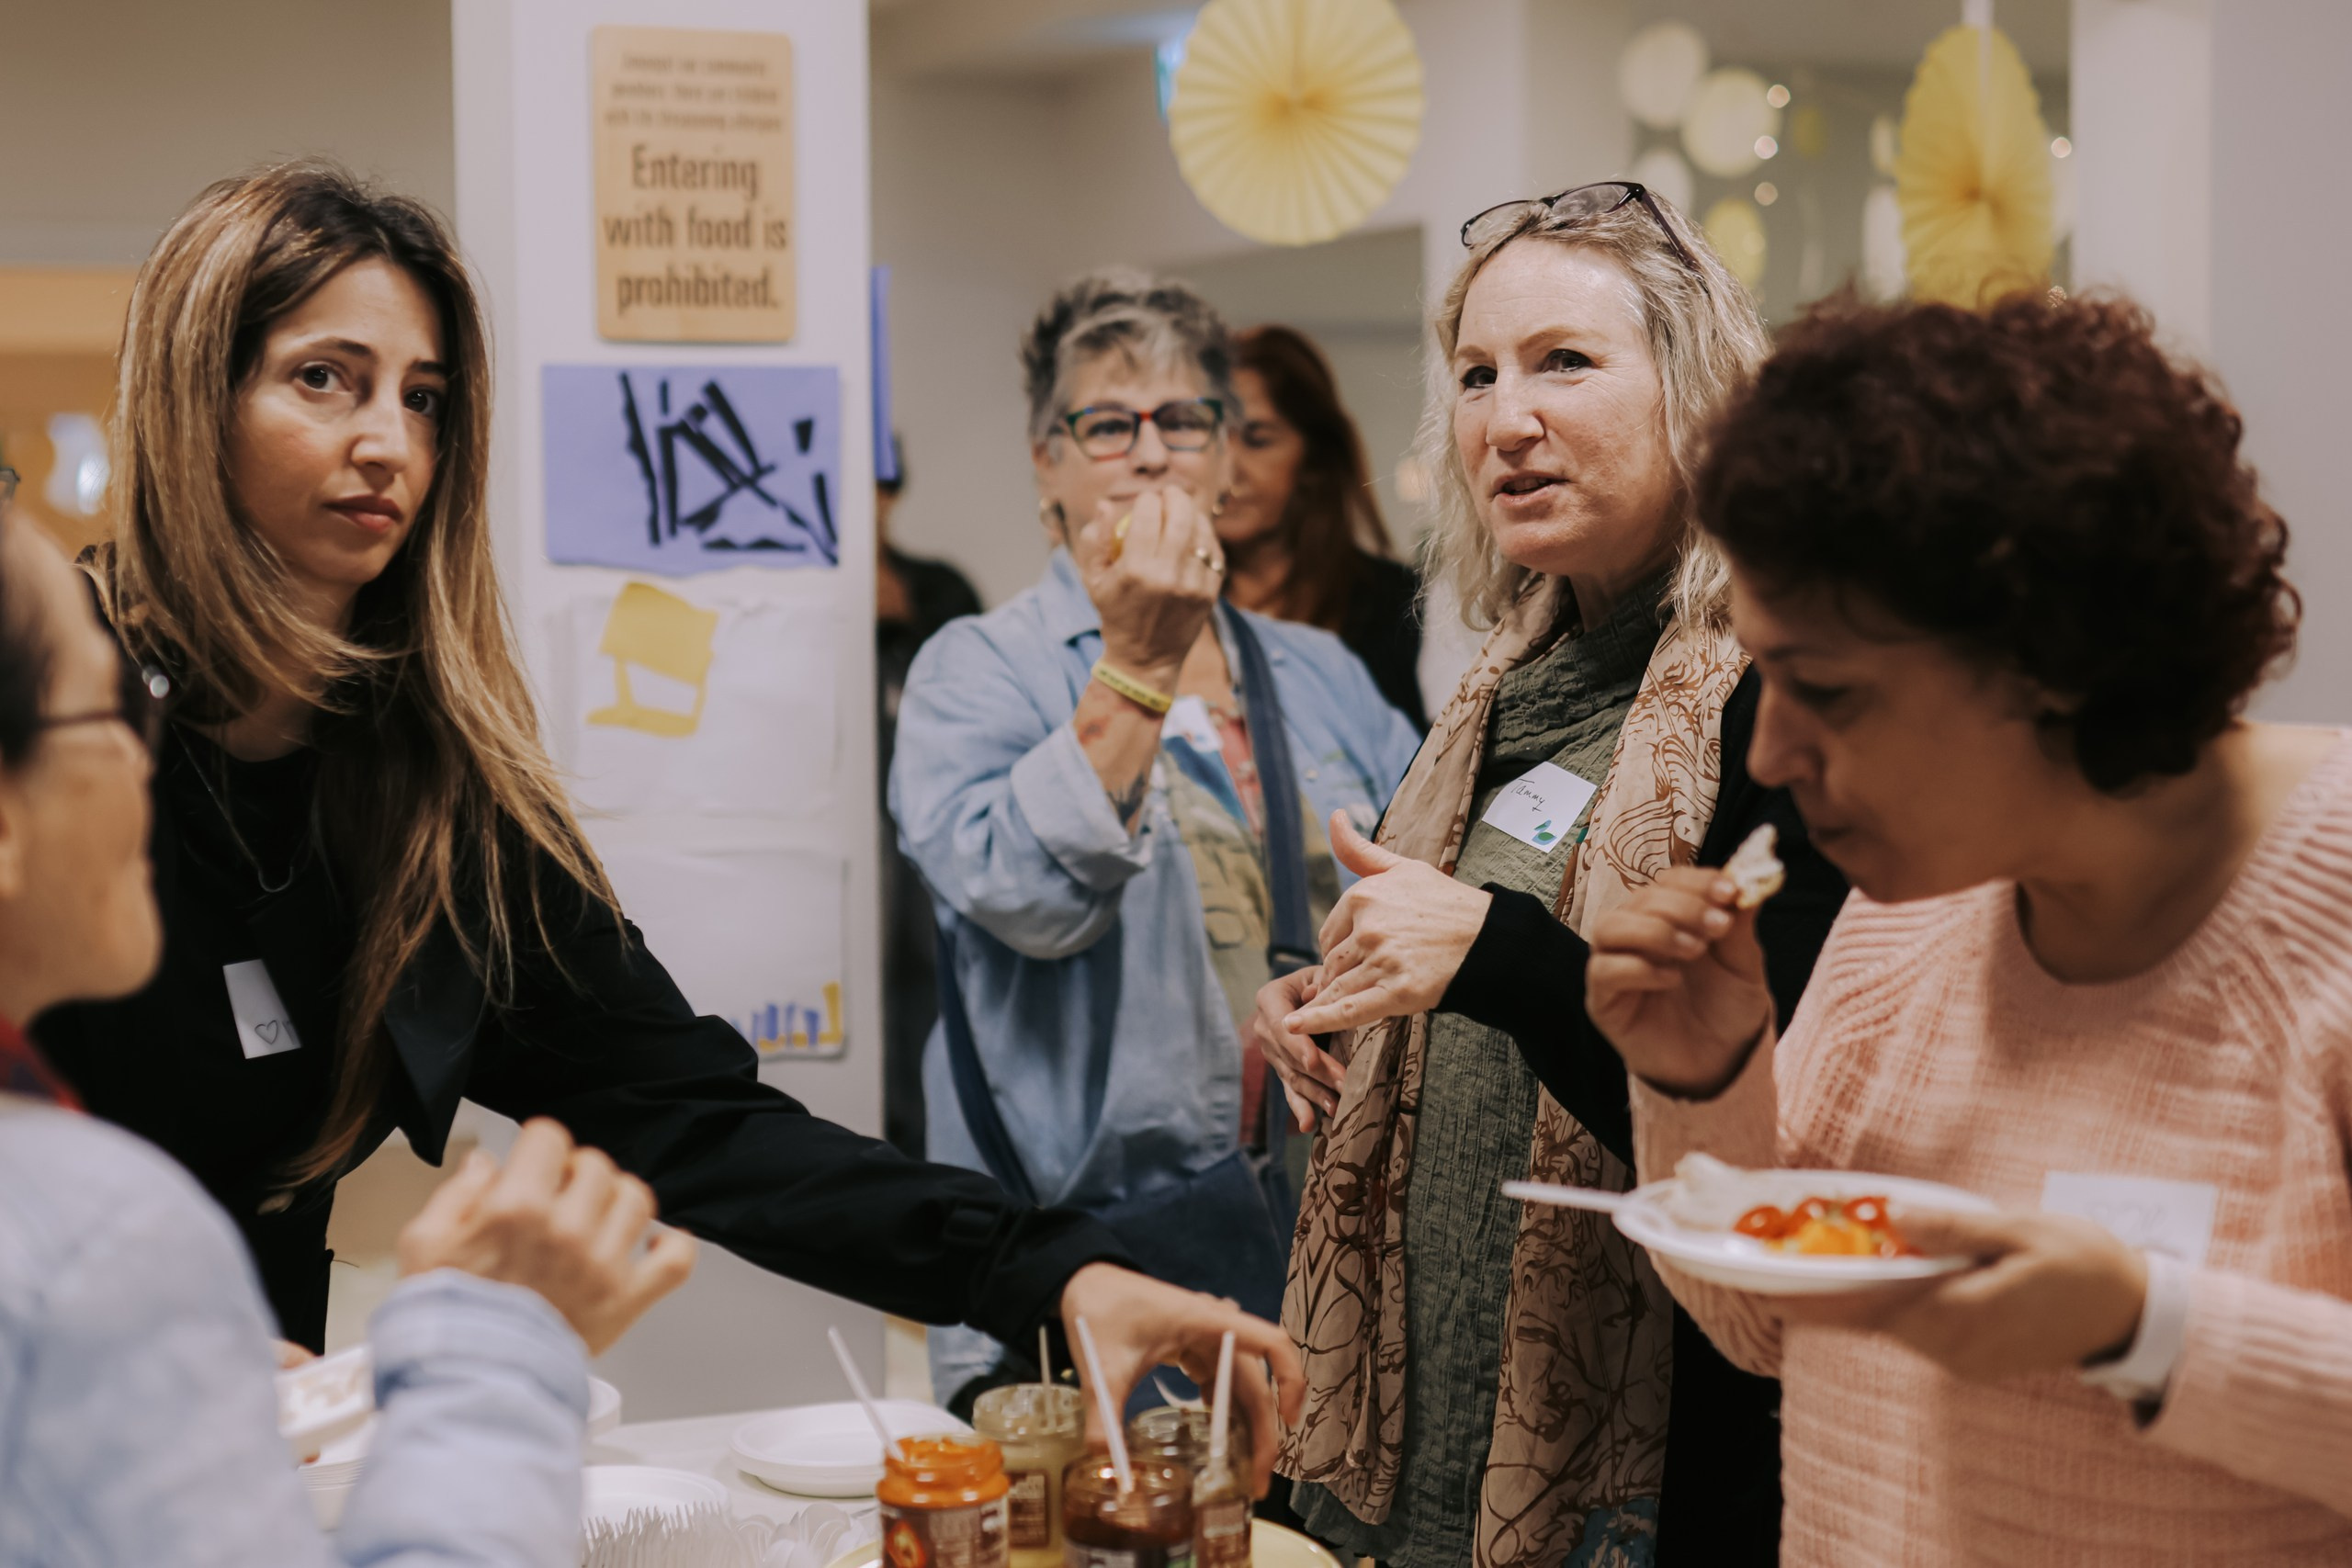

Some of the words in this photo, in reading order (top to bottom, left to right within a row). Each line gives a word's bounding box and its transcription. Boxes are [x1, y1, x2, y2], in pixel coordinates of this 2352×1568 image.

[632, 143, 758, 201] Entering
[603, 204, 674, 249] with
[686, 205, 752, 250] food
[763, 204, 787, 251] is
[616, 263, 779, 316] prohibited.
